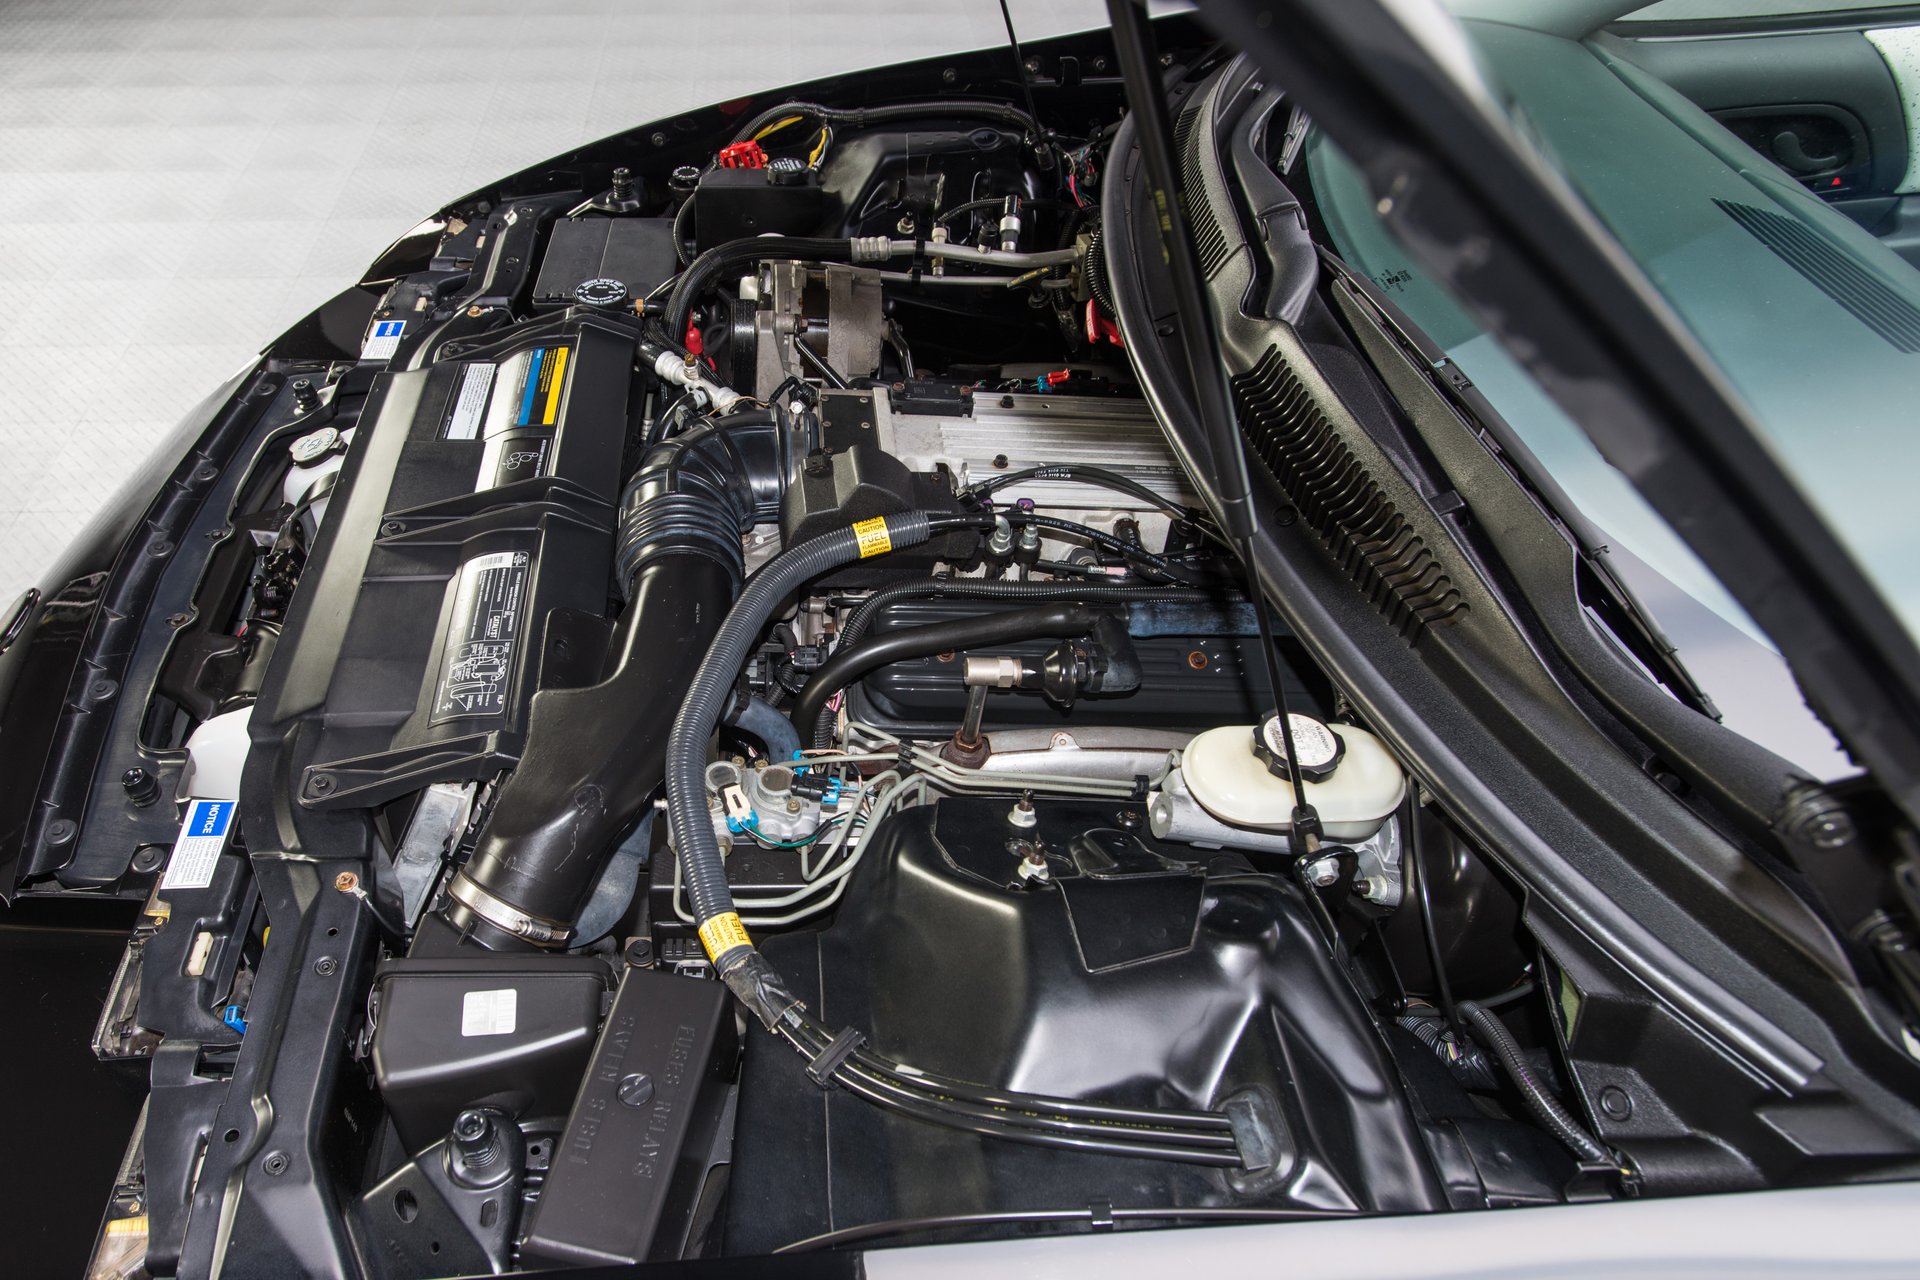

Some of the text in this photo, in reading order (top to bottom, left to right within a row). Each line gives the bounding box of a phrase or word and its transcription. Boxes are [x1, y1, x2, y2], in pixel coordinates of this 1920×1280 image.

[858, 524, 885, 534] CAUTION
[861, 532, 886, 544] FUEL
[862, 540, 888, 549] FLAMMABLE
[864, 545, 889, 555] CAUTION
[202, 804, 220, 834] NOTICE
[705, 924, 721, 954] FUEL
[718, 916, 736, 944] CAUTION
[730, 916, 747, 941] FUEL
[568, 1016, 635, 1164] FUSES RELAYS
[632, 1026, 696, 1178] FUSES RELAYS
